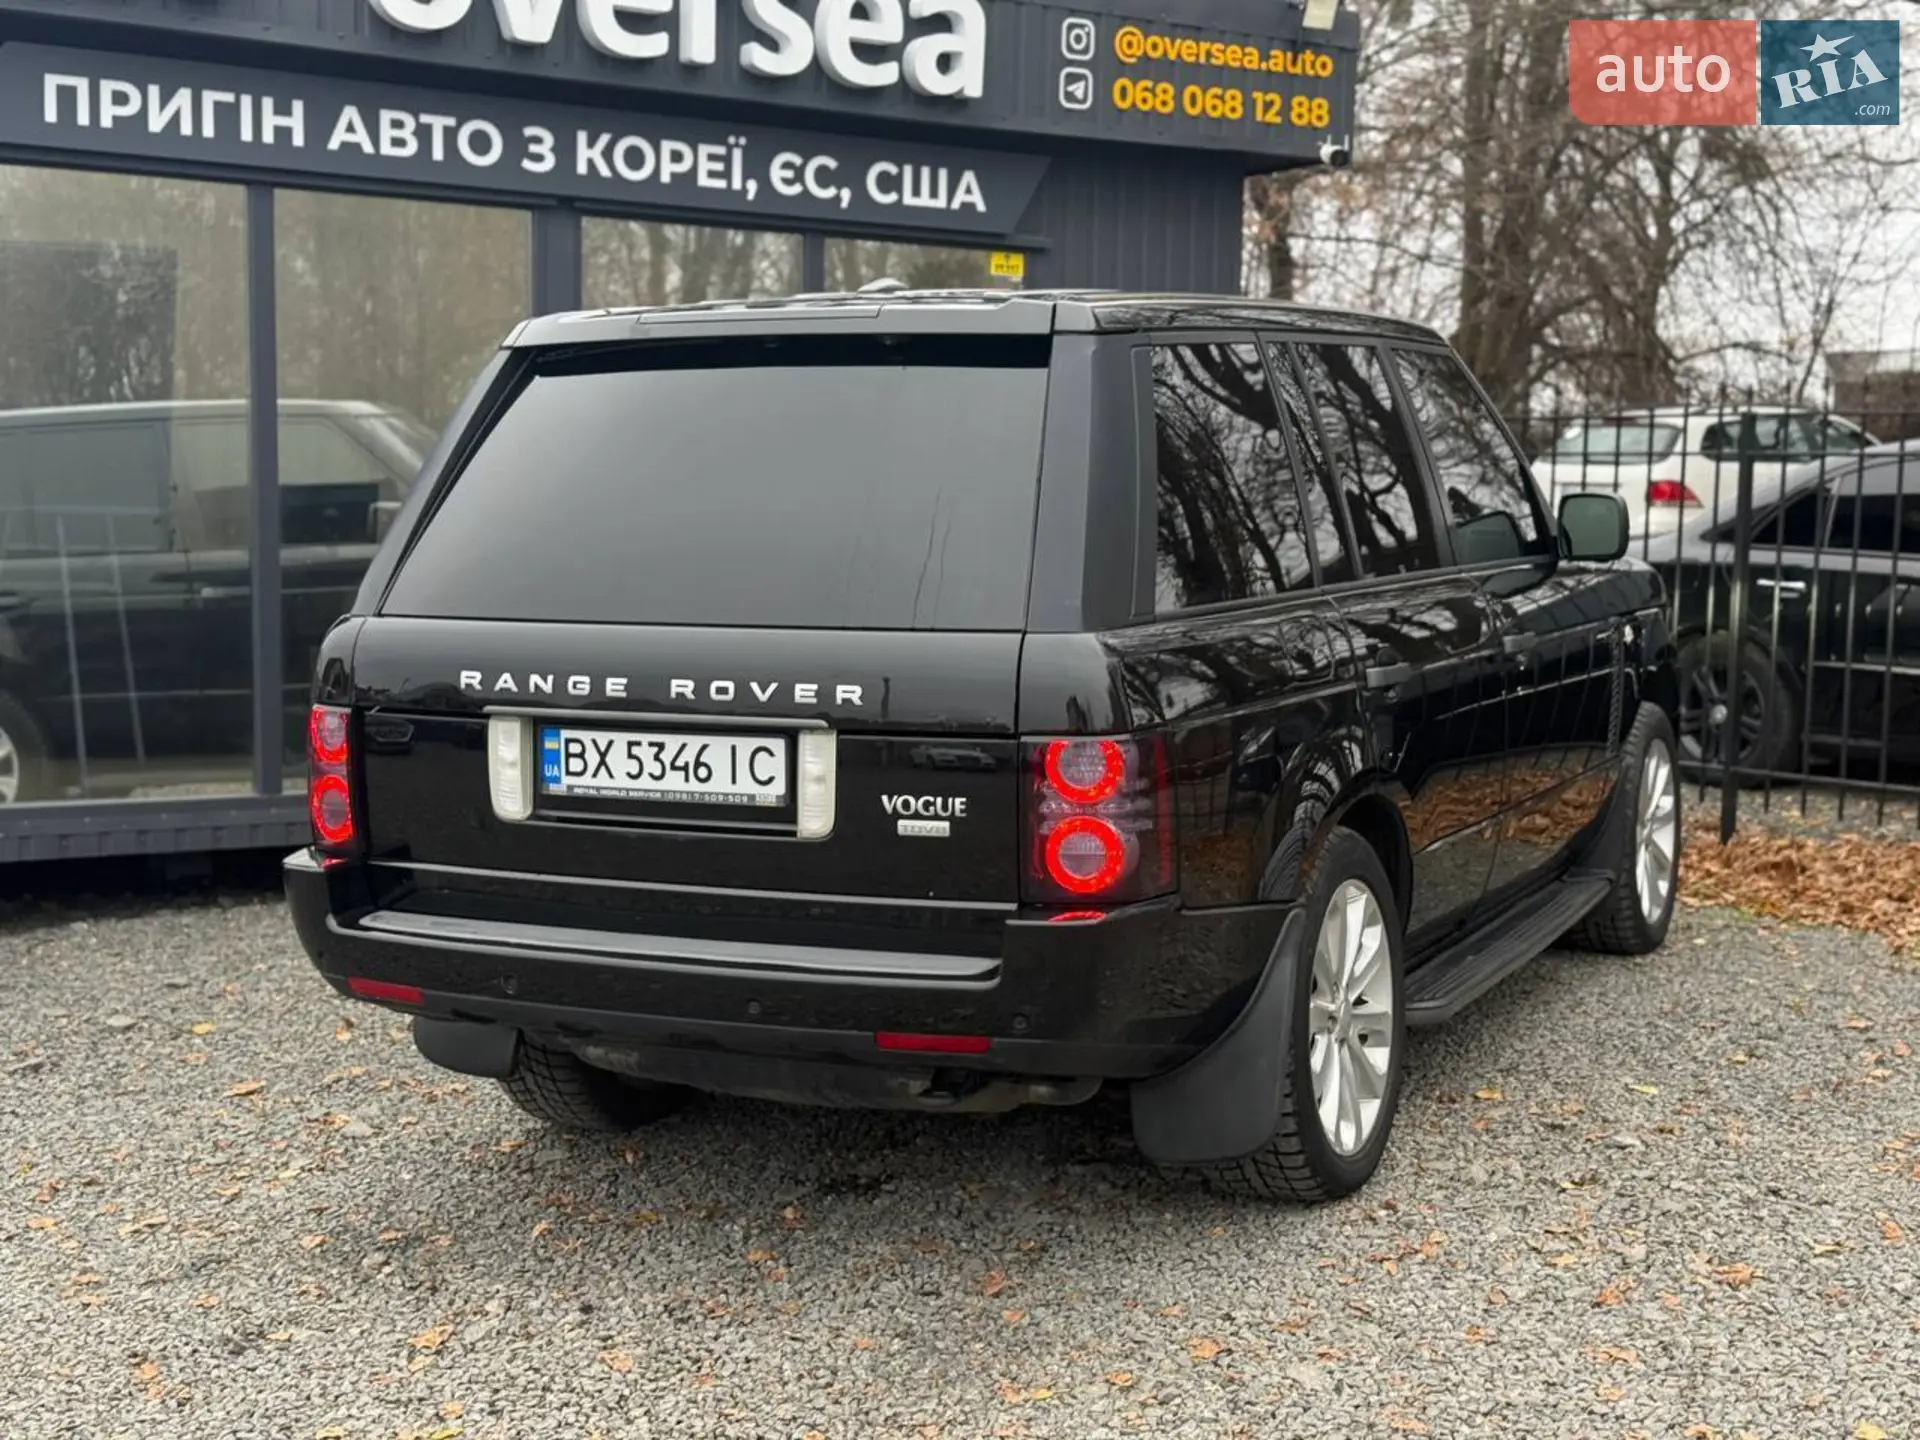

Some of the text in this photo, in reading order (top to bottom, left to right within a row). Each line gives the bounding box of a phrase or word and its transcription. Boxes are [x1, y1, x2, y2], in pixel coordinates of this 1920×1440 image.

[366, 0, 987, 99] ersea
[1114, 25, 1334, 78] @oversea.auto
[1112, 77, 1331, 129] 068 068 12 88
[42, 72, 306, 148] ПРИГІН
[326, 105, 503, 168] АВТО
[575, 129, 758, 201] КОРЕЇ,
[769, 151, 851, 209] ЄС,
[865, 160, 988, 213] США
[459, 669, 866, 707] RANGE ROVER
[544, 764, 560, 777] UA
[564, 737, 776, 786] BX 5346 IC
[880, 794, 967, 817] VOGUE
